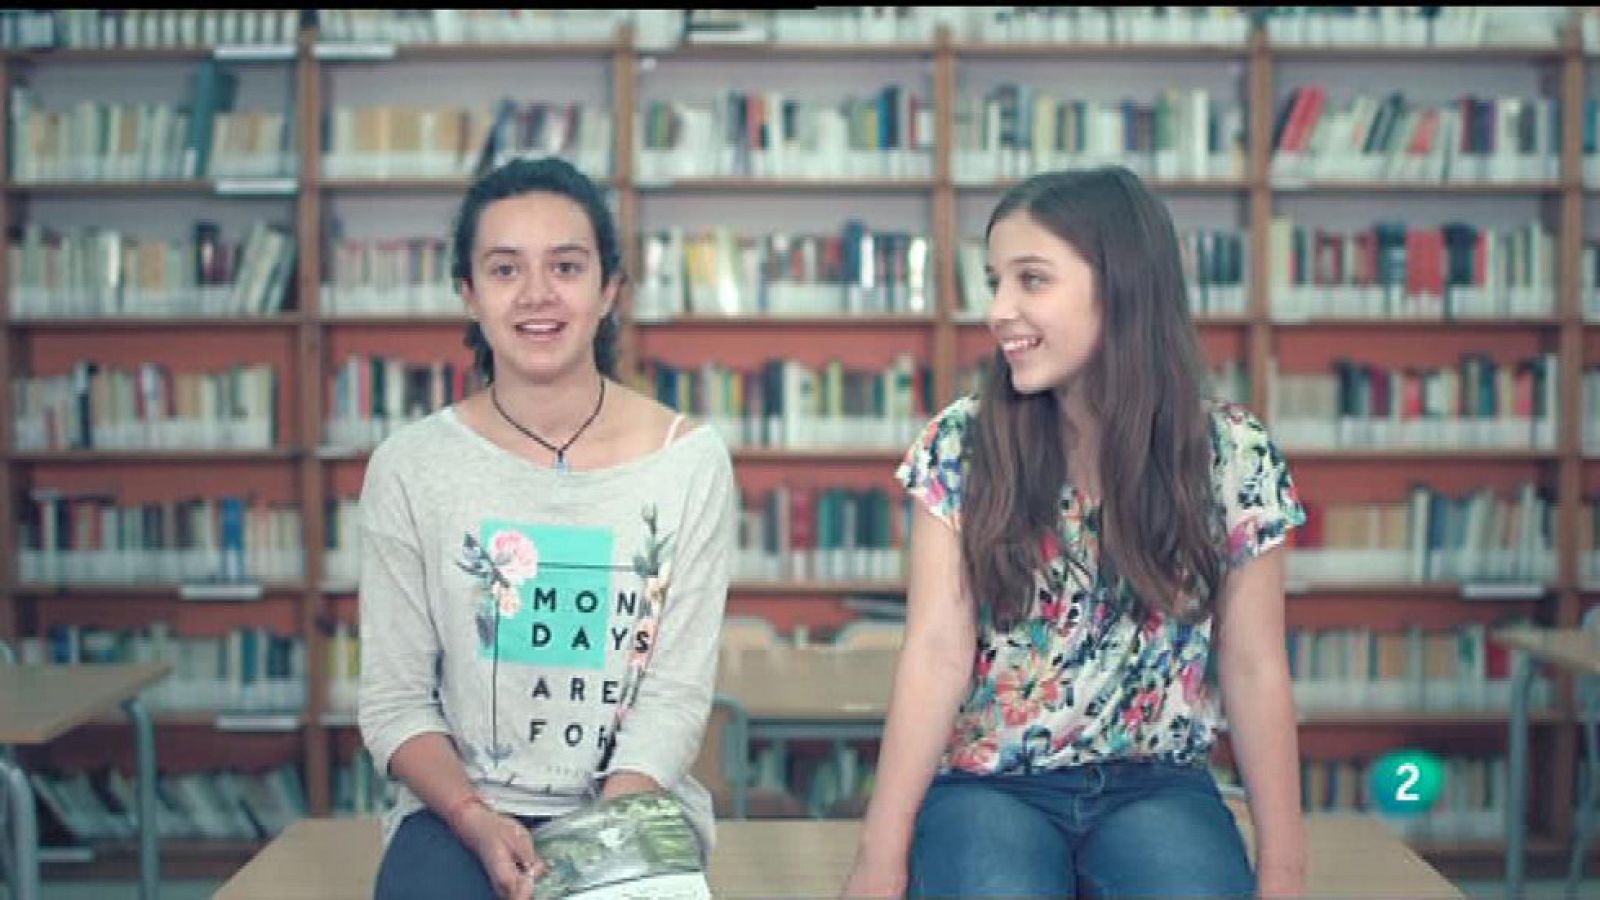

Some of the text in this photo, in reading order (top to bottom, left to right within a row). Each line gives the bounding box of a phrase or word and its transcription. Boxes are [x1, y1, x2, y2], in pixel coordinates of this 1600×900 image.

[533, 587, 636, 616] MON
[532, 622, 649, 653] DAYS
[532, 677, 618, 704] ARE
